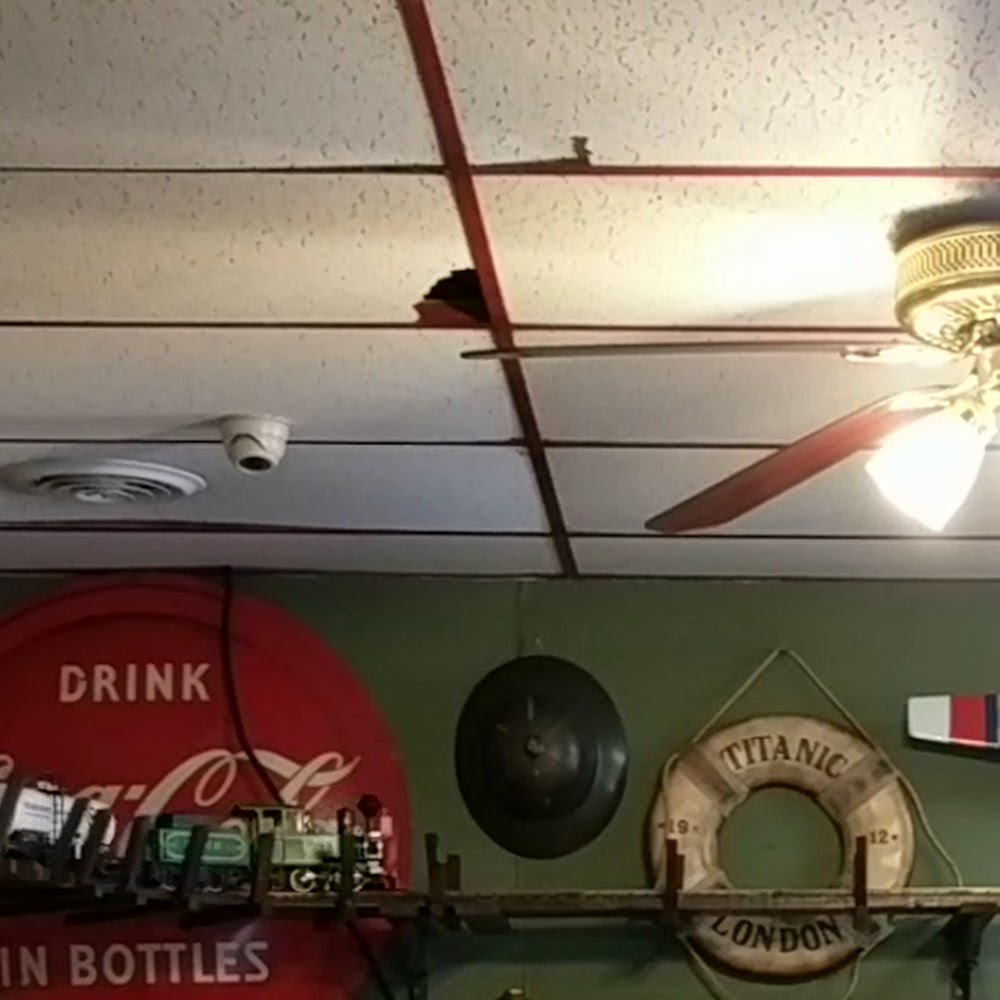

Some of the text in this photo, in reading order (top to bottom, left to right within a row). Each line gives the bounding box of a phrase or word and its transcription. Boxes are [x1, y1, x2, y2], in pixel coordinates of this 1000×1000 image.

[59, 662, 211, 703] DRINK
[720, 734, 849, 779] TITANIC
[868, 829, 889, 845] 12
[710, 915, 843, 952] LONDON
[1, 941, 270, 987] IN BOTTLES
